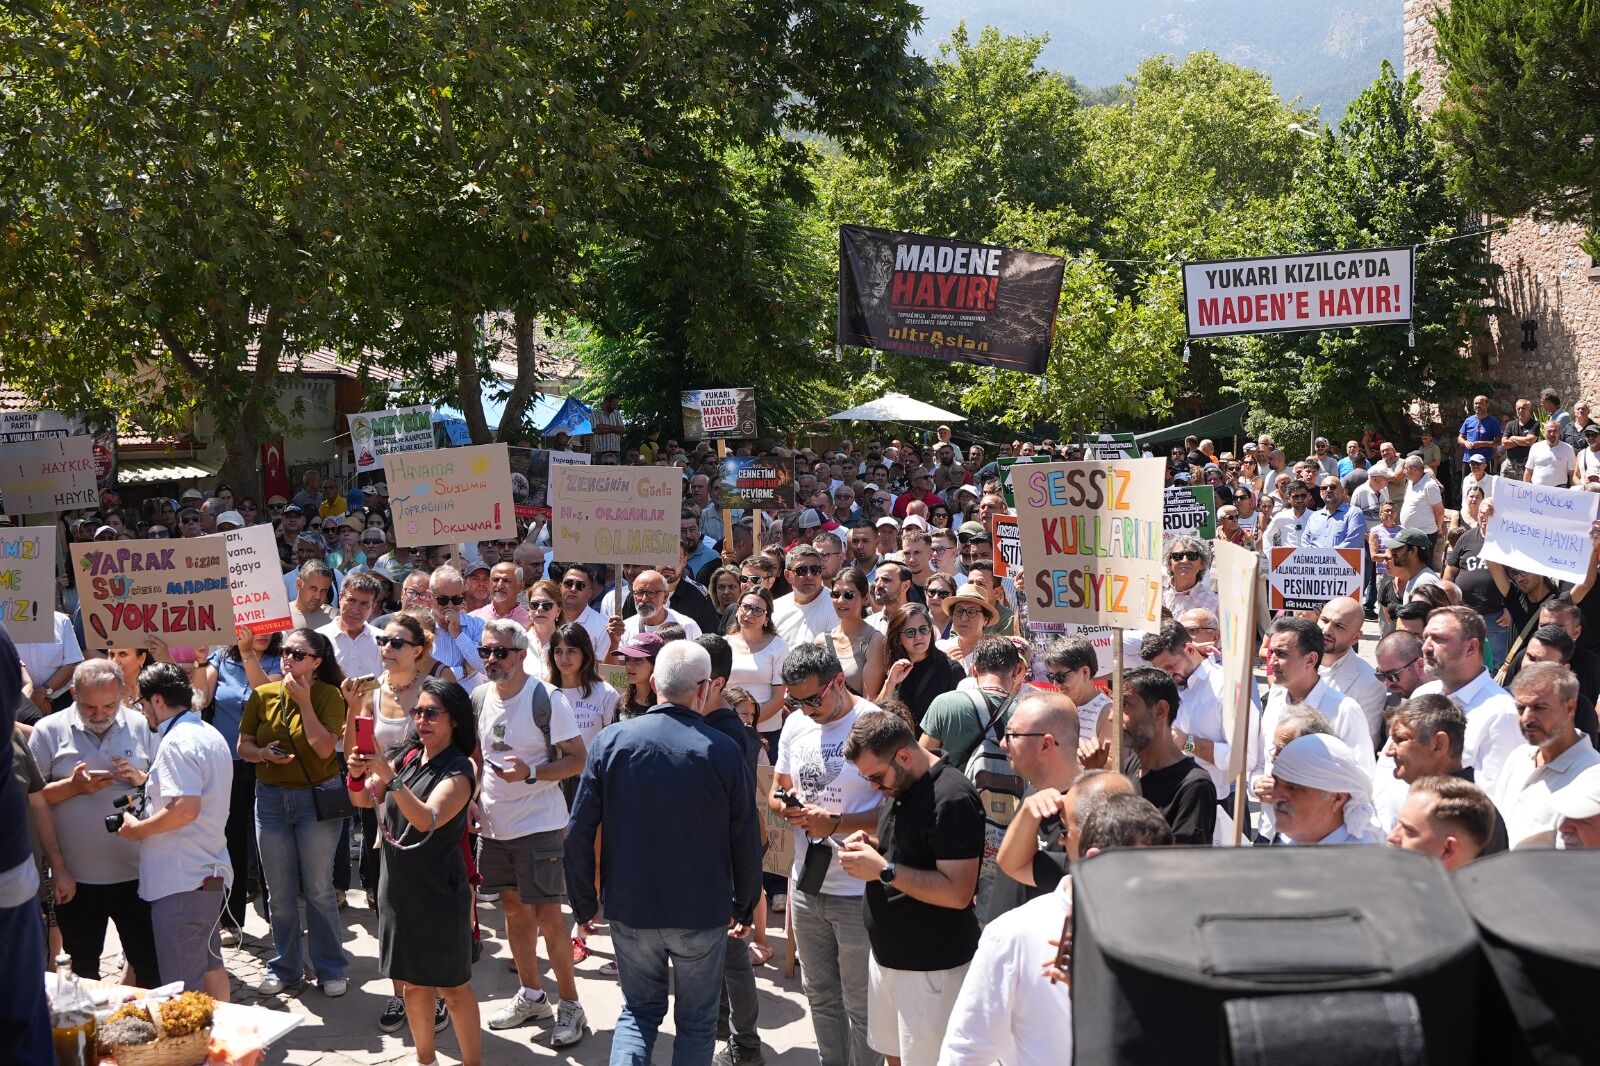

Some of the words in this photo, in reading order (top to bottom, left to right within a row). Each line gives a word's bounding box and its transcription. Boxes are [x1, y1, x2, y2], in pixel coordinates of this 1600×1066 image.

[895, 244, 1001, 276] MADENE
[1206, 265, 1277, 289] YUKARI
[1285, 258, 1390, 283] KIZILCA'DA
[891, 272, 999, 310] HAYIR!
[1198, 291, 1309, 326] MADEN'E
[1319, 284, 1400, 317] HAYIR!
[888, 327, 989, 352] ultrAslan
[701, 399, 736, 407] KIZILCA'DA
[705, 391, 730, 399] YUKARI
[703, 406, 734, 416] MADENE
[704, 415, 736, 428] HAYIR!
[371, 408, 431, 436] MEVSİM
[9, 433, 33, 441] YUKARI
[41, 458, 92, 474] HAYKIR
[738, 468, 776, 479] CENNETİMİ
[54, 489, 97, 505] HAYIR
[741, 488, 774, 499] ÇEVİRME
[1028, 466, 1131, 511] SESSİZ
[1508, 483, 1532, 499] TÜM
[1536, 492, 1574, 510] CANLILAR
[594, 507, 665, 522] ORMANLAR
[1500, 518, 1540, 539] MADENE
[594, 527, 678, 555] OLMASIN
[84, 548, 176, 576] YAPRAK
[1293, 554, 1338, 565] YAĞMACILARIN,
[92, 576, 128, 600] SU
[166, 577, 228, 595] MADENE
[1035, 565, 1128, 613] SESİYİZ
[1284, 578, 1348, 597] PEŞİNDEYİZ!
[103, 602, 159, 633] YOK
[162, 600, 222, 633] İZİN.
